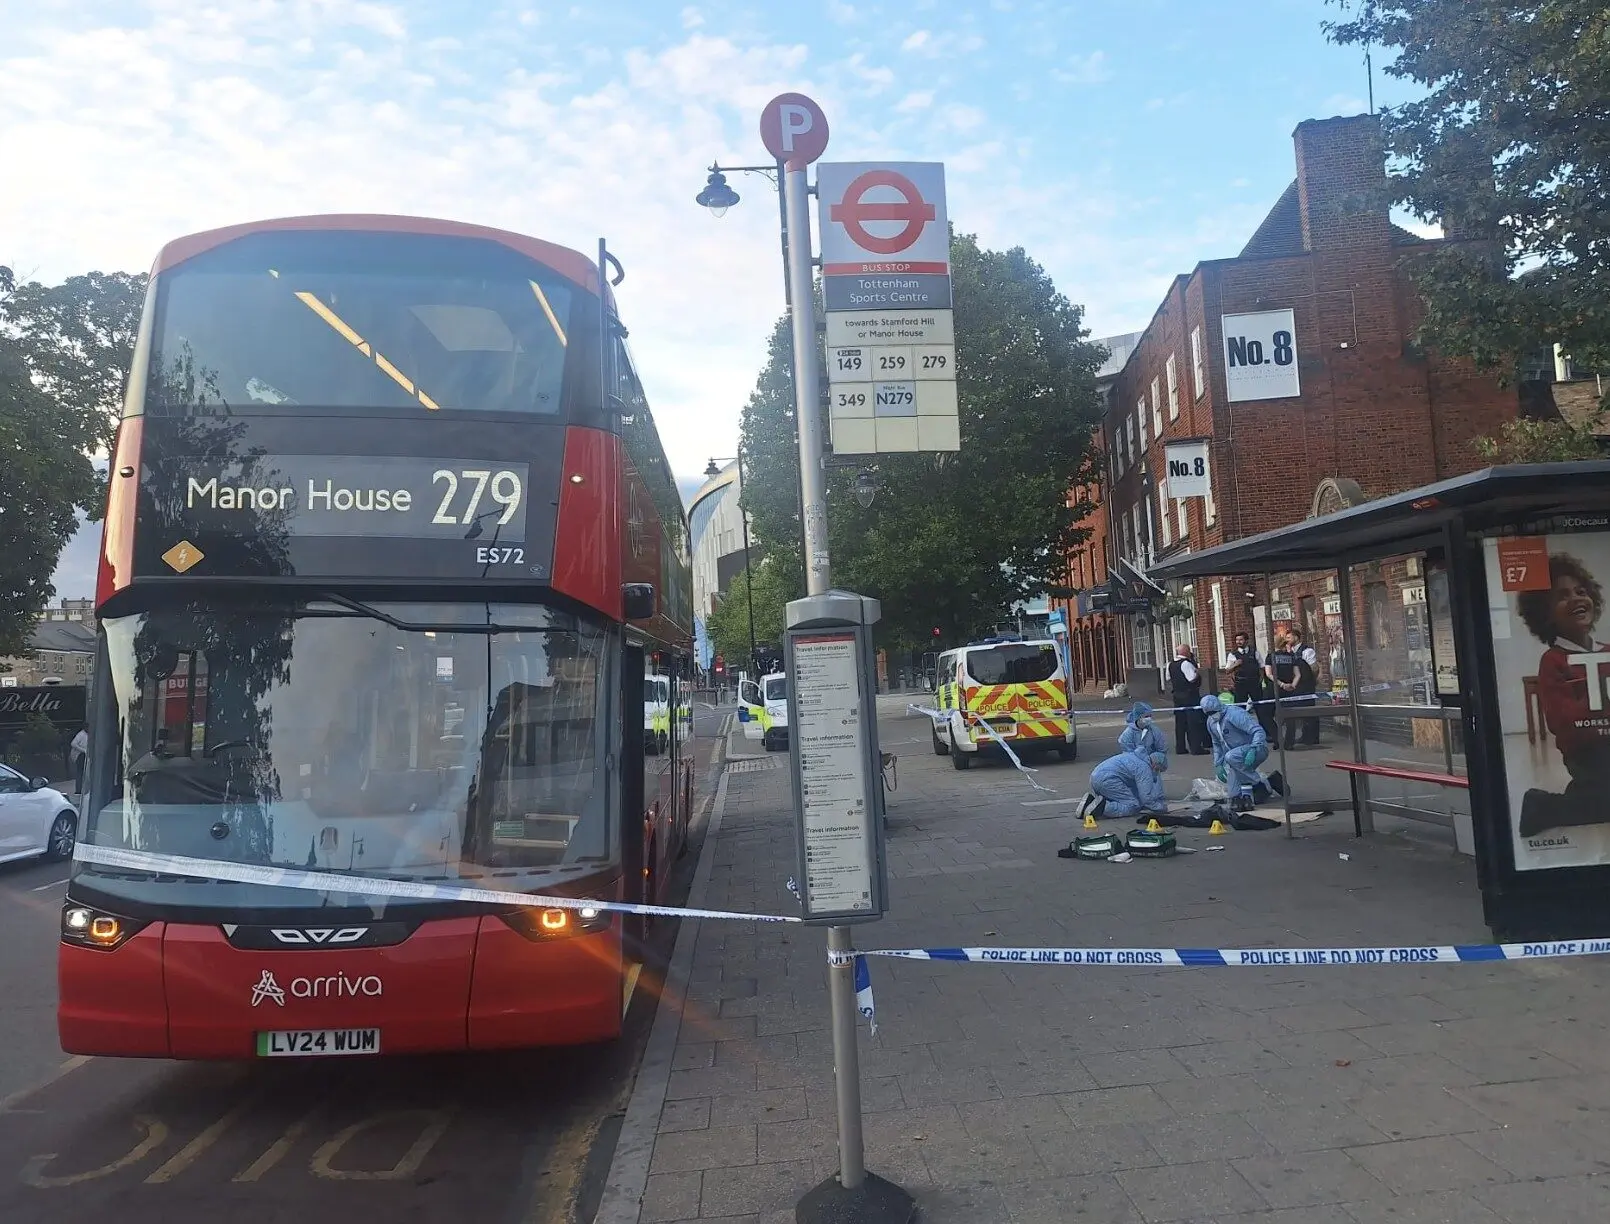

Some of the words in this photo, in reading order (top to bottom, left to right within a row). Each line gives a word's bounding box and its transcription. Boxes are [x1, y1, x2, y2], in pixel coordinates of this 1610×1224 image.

[780, 104, 812, 152] P
[863, 264, 881, 272] BUS
[885, 263, 911, 271] STOP
[858, 279, 919, 289] Tottenham
[850, 293, 886, 304] Sports
[890, 292, 928, 302] Centre
[845, 319, 879, 327] towards
[881, 318, 918, 326] Stamford
[837, 357, 862, 371] 149
[880, 356, 906, 369] 259
[922, 355, 947, 368] 279
[838, 393, 866, 406] 349
[876, 392, 913, 405] N279
[187, 478, 293, 510] Manor
[308, 479, 412, 511] House
[431, 469, 522, 525] 279
[1562, 517, 1608, 527] JCDecaux
[476, 548, 524, 564] ES72
[1506, 566, 1527, 582] £7
[169, 678, 208, 688] BUGE
[1566, 652, 1610, 711] T
[0, 692, 62, 711] Bella
[979, 704, 1007, 712] POLICE
[1028, 700, 1055, 708] POLICE
[1574, 718, 1609, 727] WORKS
[1528, 835, 1569, 847] tu.co.uk
[1241, 951, 1290, 964] POLICE
[1295, 951, 1326, 964] LINE
[1331, 950, 1350, 963] DO
[1356, 950, 1385, 963] NOT
[1390, 948, 1439, 962] CROSS
[1523, 943, 1576, 956] POLICE
[981, 950, 1026, 961] POLICE
[1030, 951, 1060, 962] LINE
[1063, 952, 1082, 963] DO
[1086, 952, 1113, 963] NOT
[1117, 952, 1163, 964] CROSS
[291, 971, 382, 997] arriva
[271, 1032, 327, 1052] LV24
[334, 1030, 375, 1050] WUM
